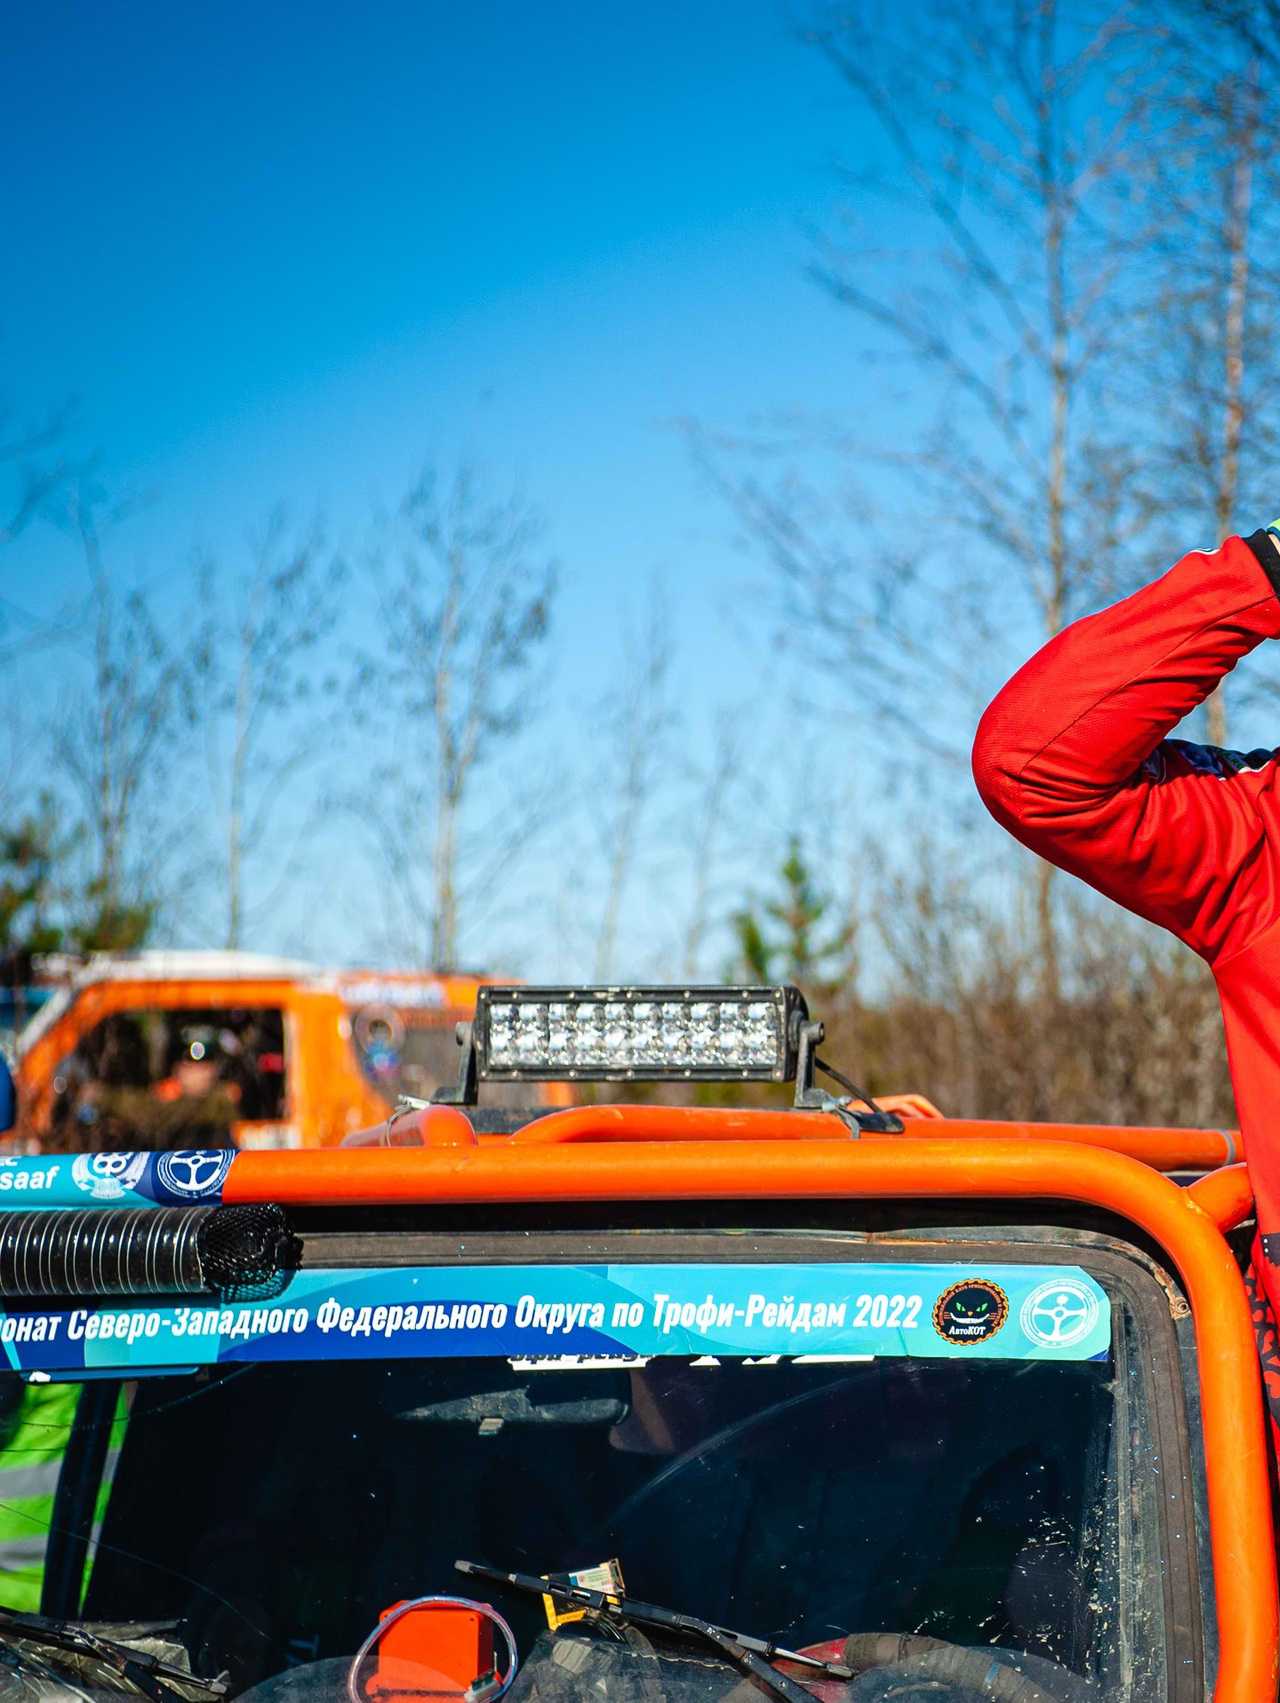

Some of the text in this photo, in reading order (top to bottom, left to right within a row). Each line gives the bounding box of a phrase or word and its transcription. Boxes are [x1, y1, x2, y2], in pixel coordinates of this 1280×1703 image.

[0, 1315, 61, 1343] онат
[67, 1307, 308, 1345] Северо-Западного
[317, 1297, 508, 1338] Федерального
[514, 1294, 605, 1334] Округа
[611, 1302, 644, 1327] по
[653, 1293, 847, 1333] Трофи-Рейдам
[853, 1295, 923, 1328] 2022
